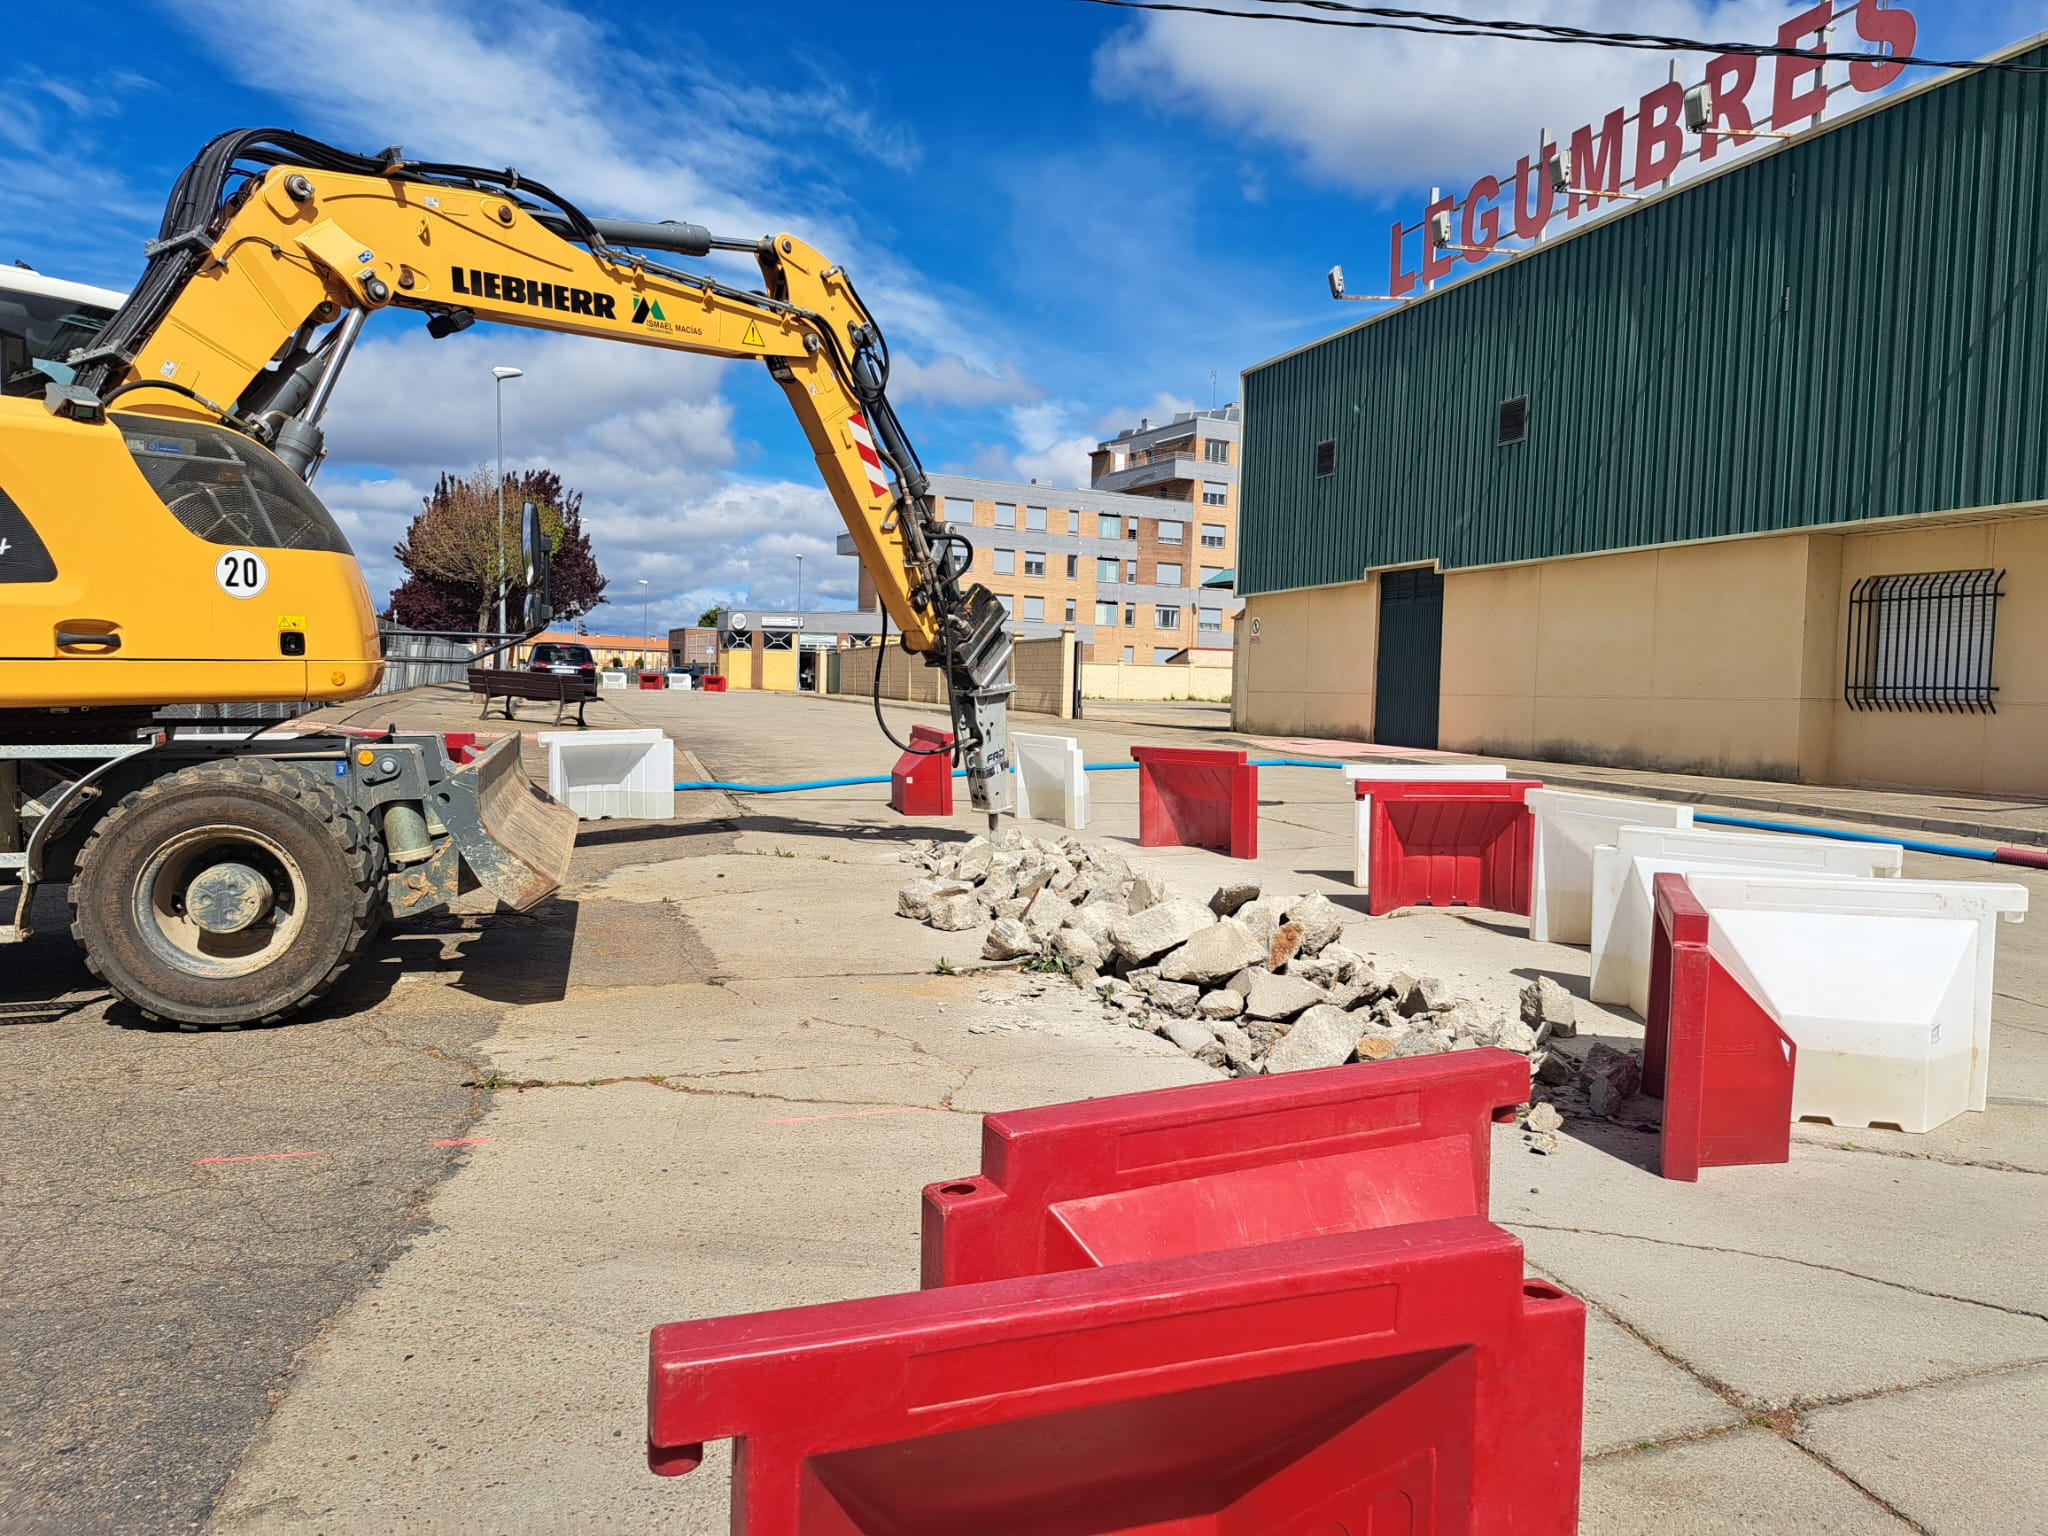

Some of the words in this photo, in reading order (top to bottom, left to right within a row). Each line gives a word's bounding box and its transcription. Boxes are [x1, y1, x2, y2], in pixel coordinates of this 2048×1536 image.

[1390, 0, 1916, 297] LEGUMBRES
[451, 266, 617, 320] LIEBHERR
[646, 319, 673, 331] ISMAEL
[224, 556, 258, 588] 20
